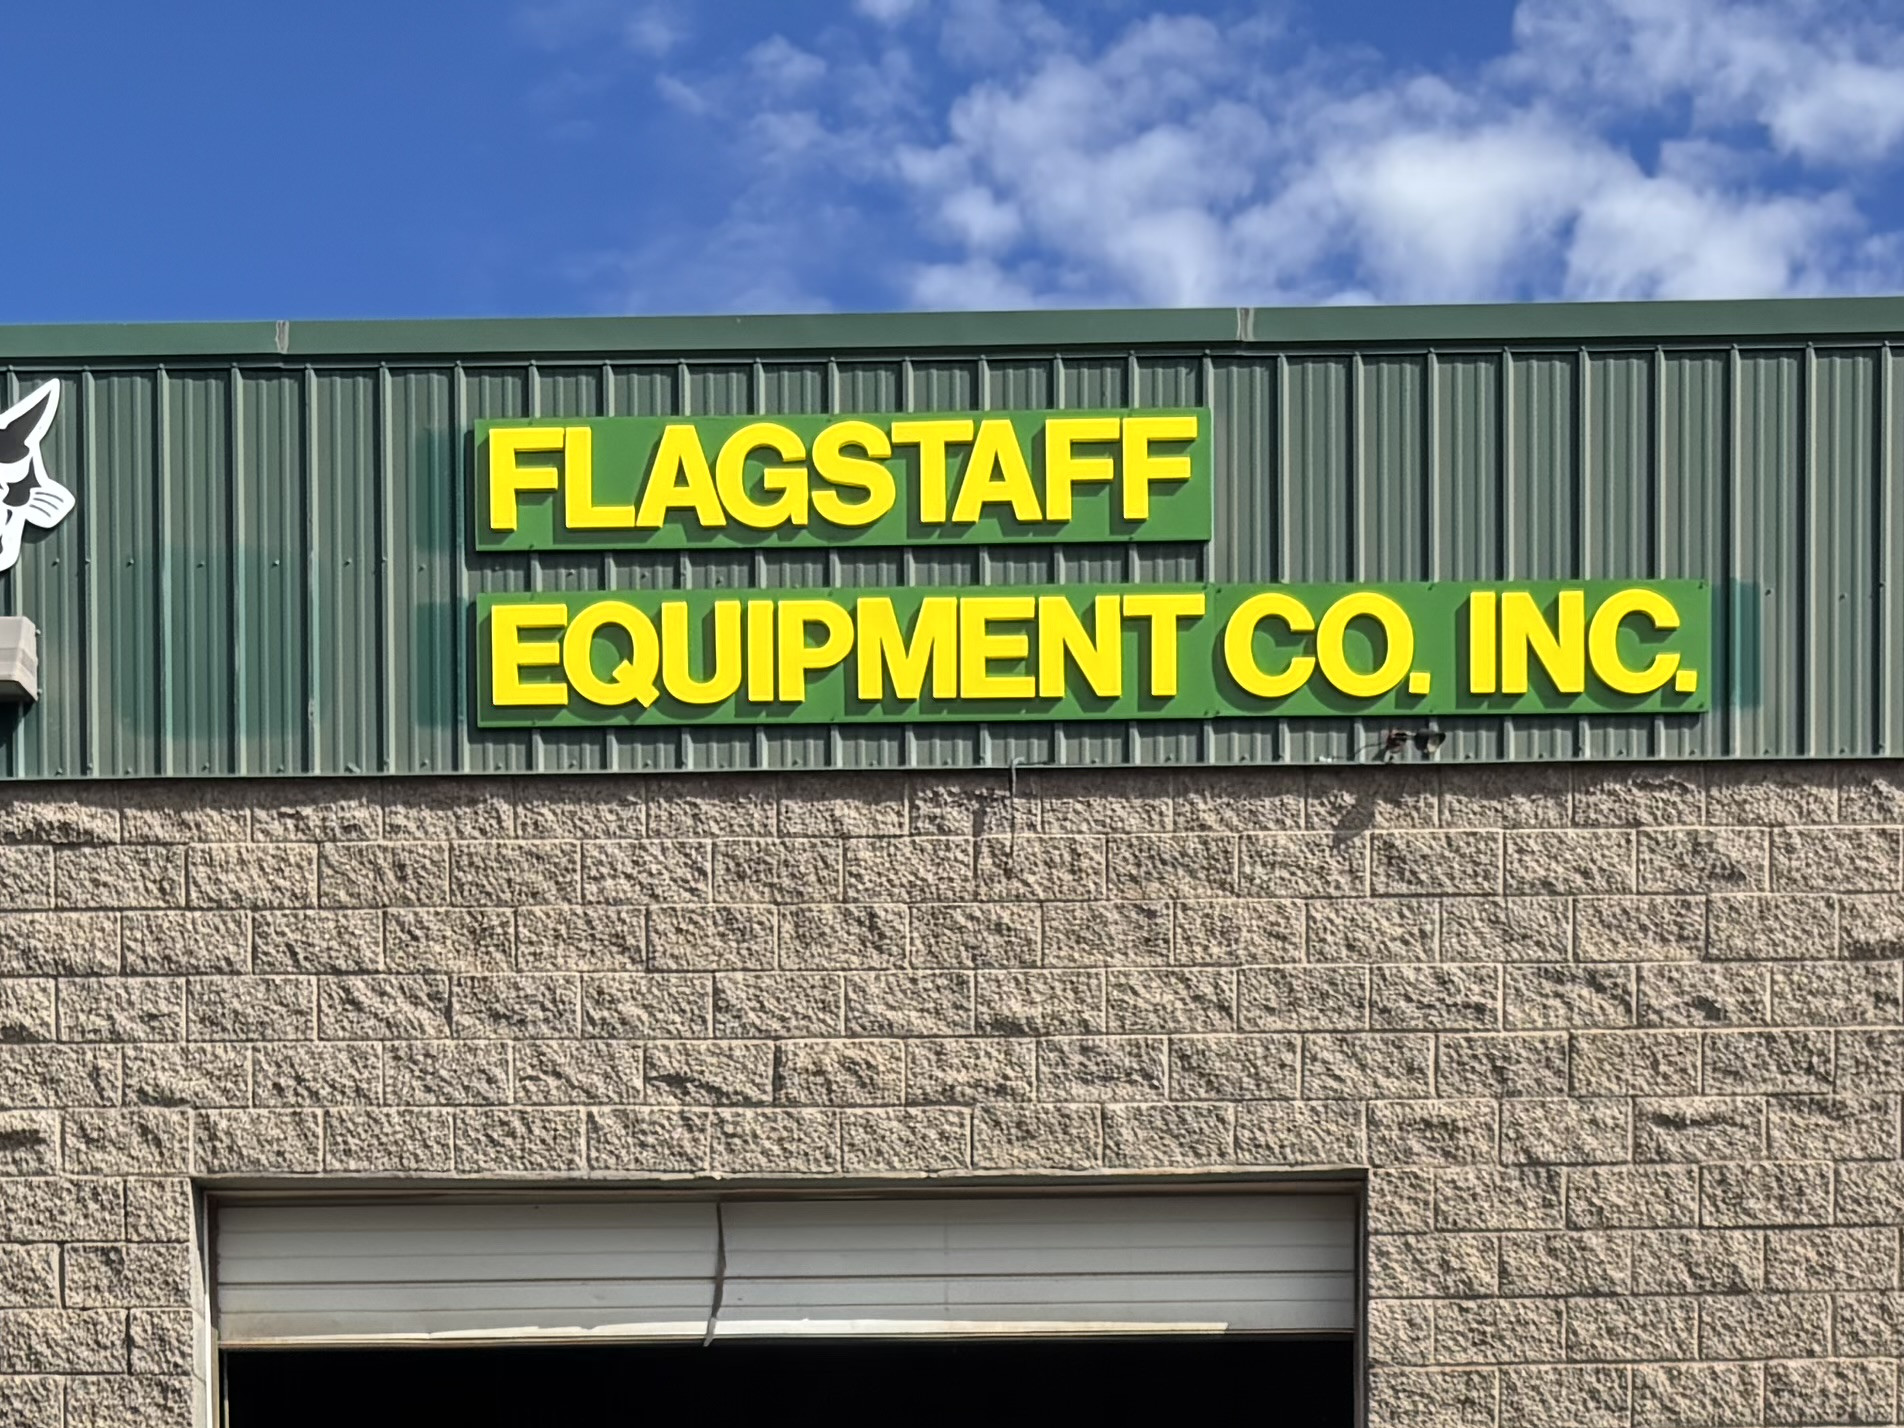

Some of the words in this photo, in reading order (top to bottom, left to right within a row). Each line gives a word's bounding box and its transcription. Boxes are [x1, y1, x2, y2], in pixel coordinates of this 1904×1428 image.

[488, 416, 1199, 530] FLAGSTAFF
[489, 593, 1205, 708] EQUIPMENT
[1223, 592, 1431, 699] CO.
[1468, 589, 1698, 694] INC.
